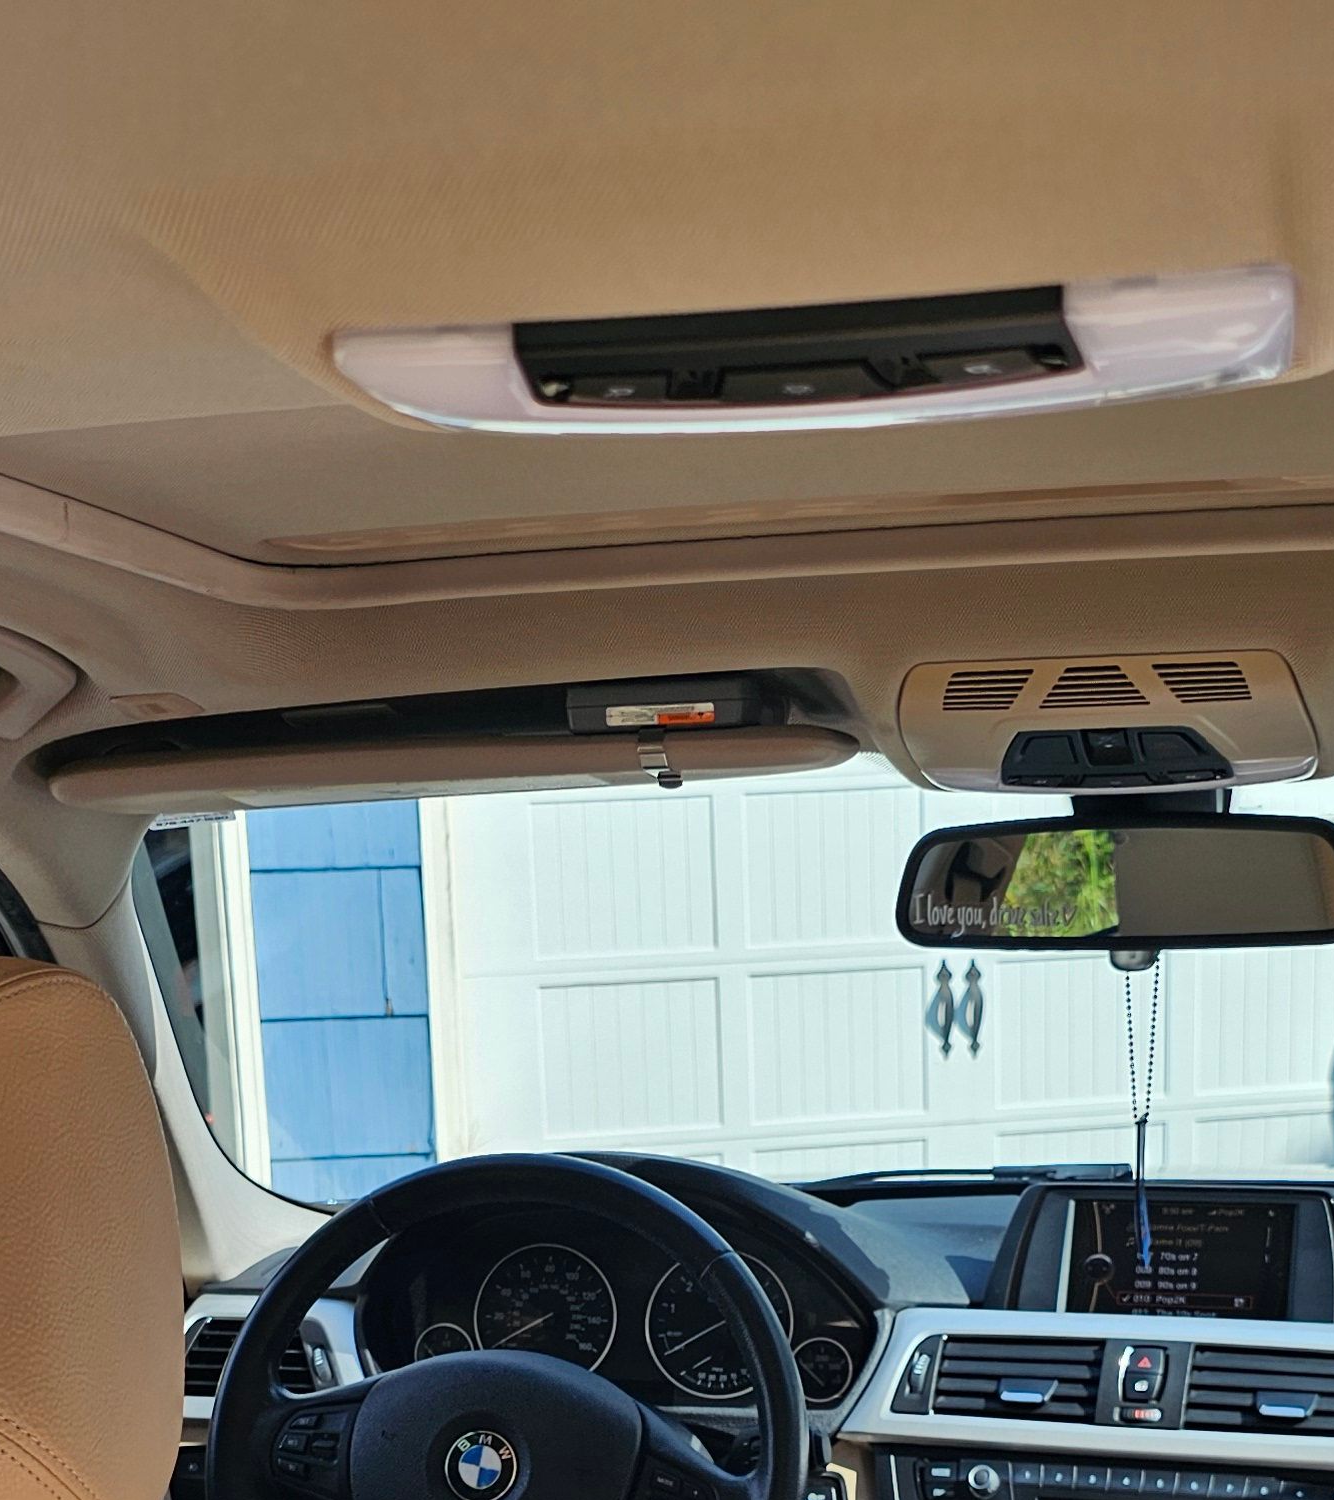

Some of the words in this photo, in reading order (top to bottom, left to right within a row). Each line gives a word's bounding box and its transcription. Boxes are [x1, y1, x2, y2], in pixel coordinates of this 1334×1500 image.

[913, 893, 924, 924] I
[927, 894, 954, 926] love
[951, 904, 986, 938] you,
[989, 896, 1025, 926] drive
[1030, 899, 1058, 927] safe
[686, 1281, 694, 1293] 2
[457, 1433, 513, 1460] BMW
